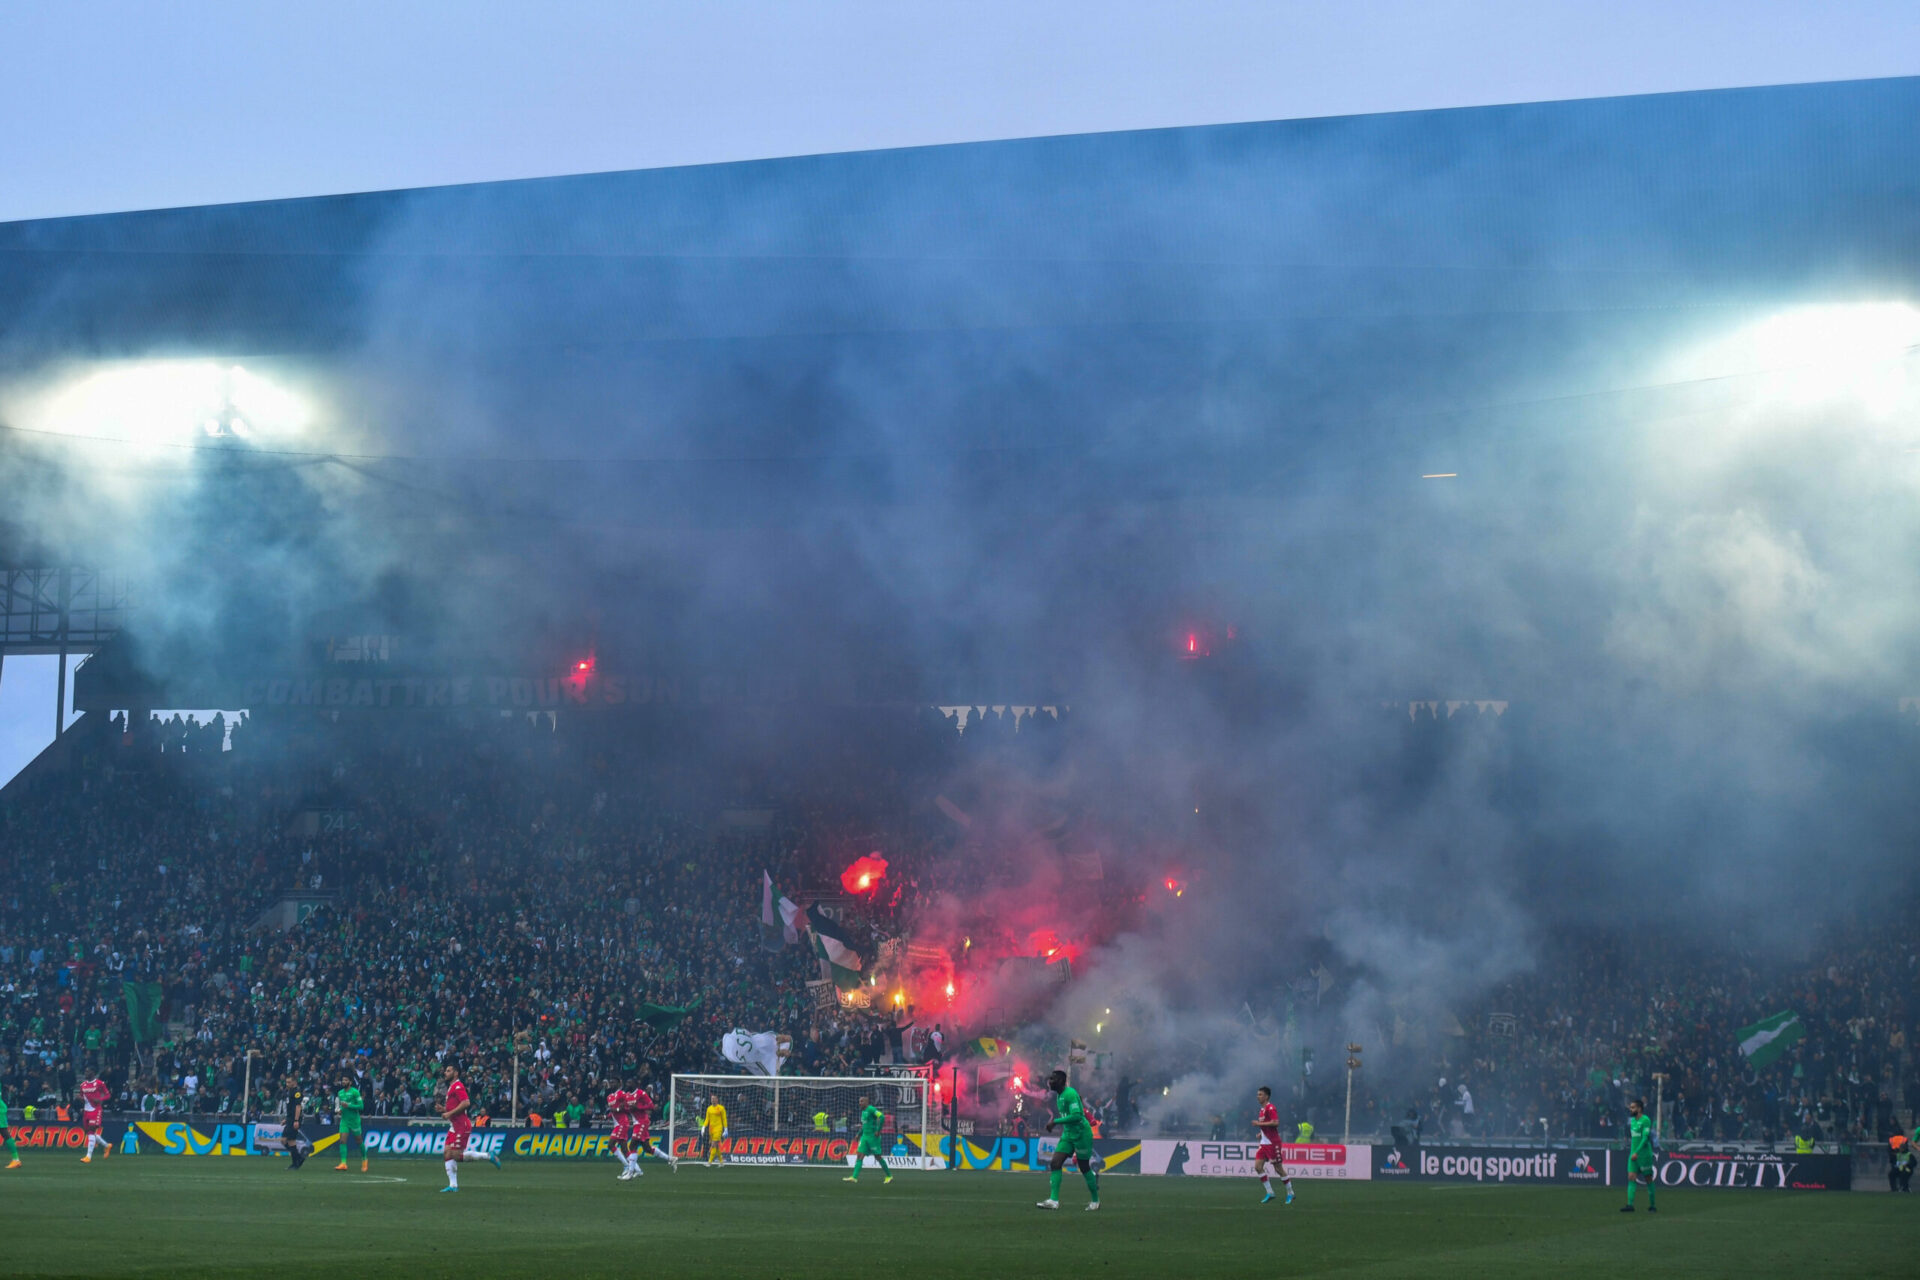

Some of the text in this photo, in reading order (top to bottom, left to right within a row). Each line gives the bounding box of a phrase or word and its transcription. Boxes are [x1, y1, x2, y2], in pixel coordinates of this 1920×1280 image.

[244, 676, 473, 706] COMBATTRE
[323, 814, 344, 832] 24
[364, 1131, 505, 1154] PLOMBRIE
[514, 1133, 663, 1157] CHAUFFE
[730, 1154, 740, 1162] le
[740, 1155, 757, 1164] coq
[757, 1155, 786, 1164] sportif
[1420, 1150, 1557, 1181] le coq sportif
